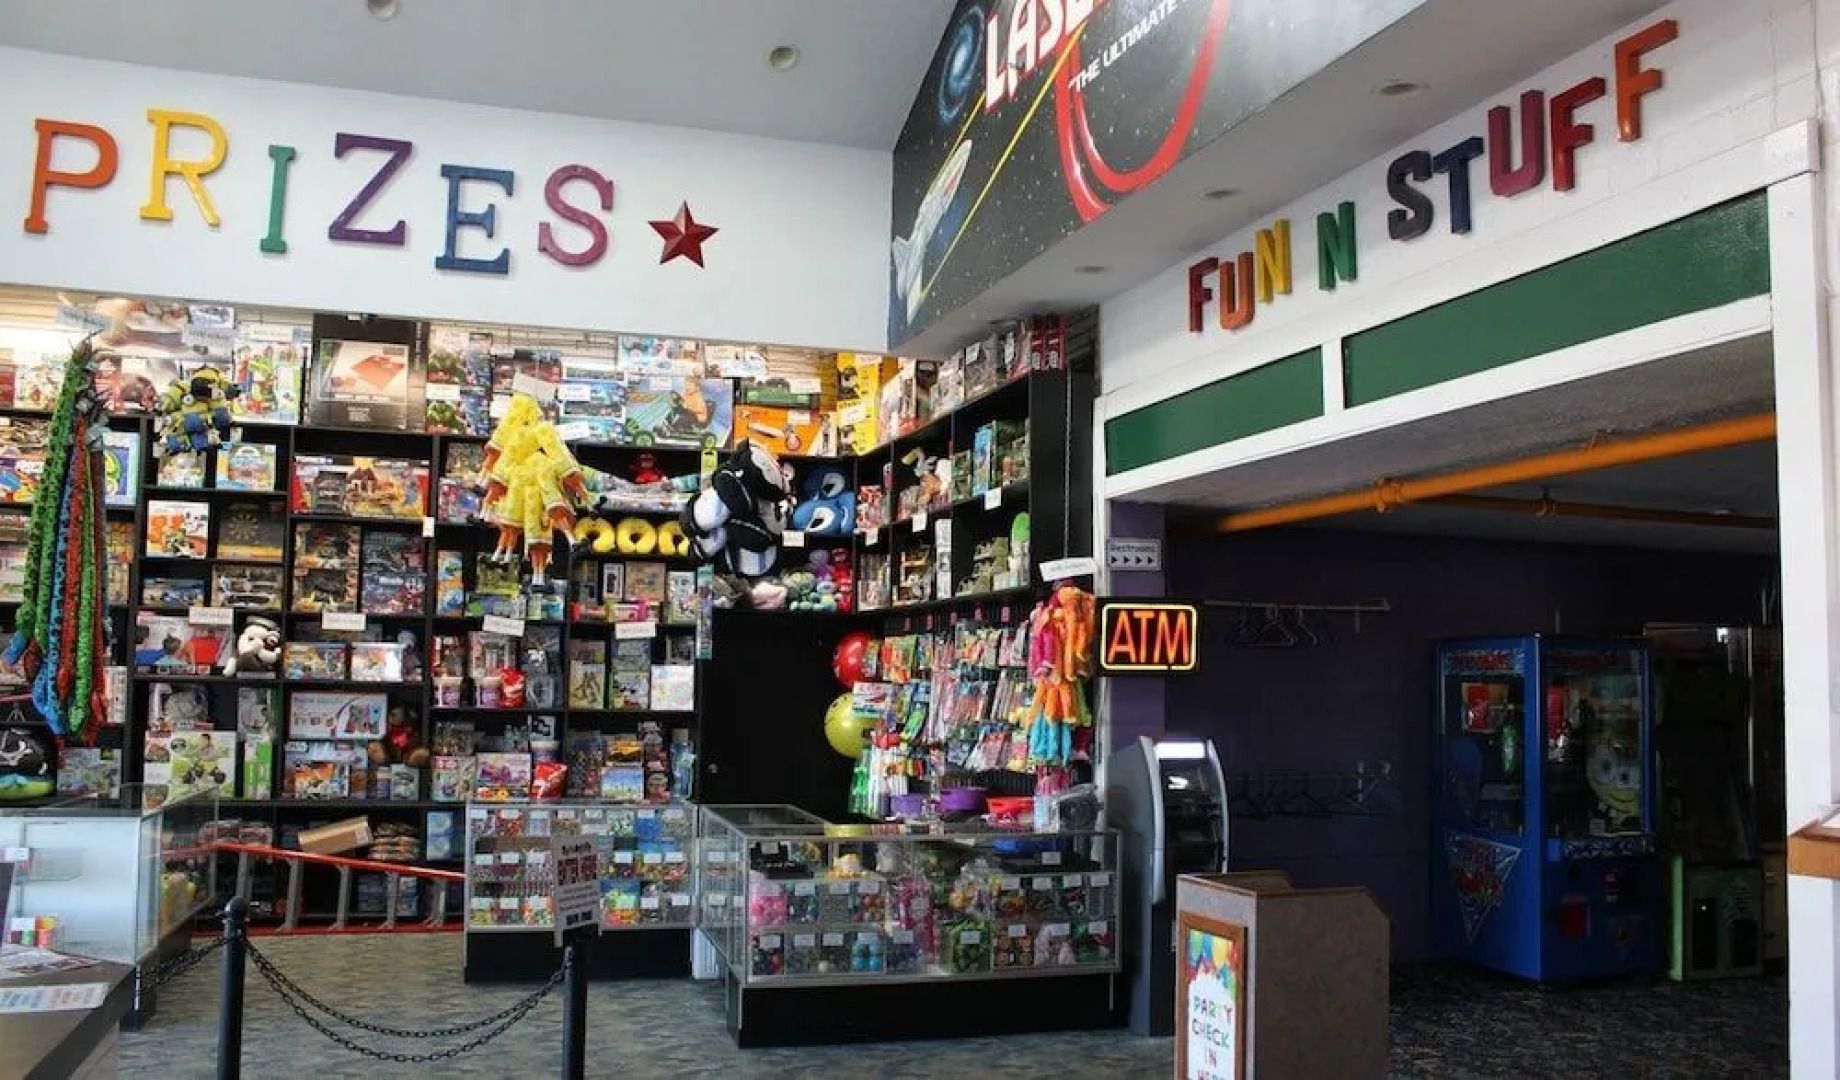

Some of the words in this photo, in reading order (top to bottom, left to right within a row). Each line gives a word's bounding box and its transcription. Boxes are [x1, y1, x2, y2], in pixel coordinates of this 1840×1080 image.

[1068, 58, 1101, 92] THE
[1103, 0, 1178, 67] ULTIMATE
[22, 108, 615, 275] PRIZES
[1188, 218, 1292, 333] FUN
[1317, 200, 1357, 291] N
[1387, 19, 1678, 242] STUFF
[1107, 610, 1190, 664] ATM
[1192, 1018, 1230, 1049] CHECK
[1193, 995, 1233, 1025] PARTY
[1204, 1045, 1218, 1068] IN
